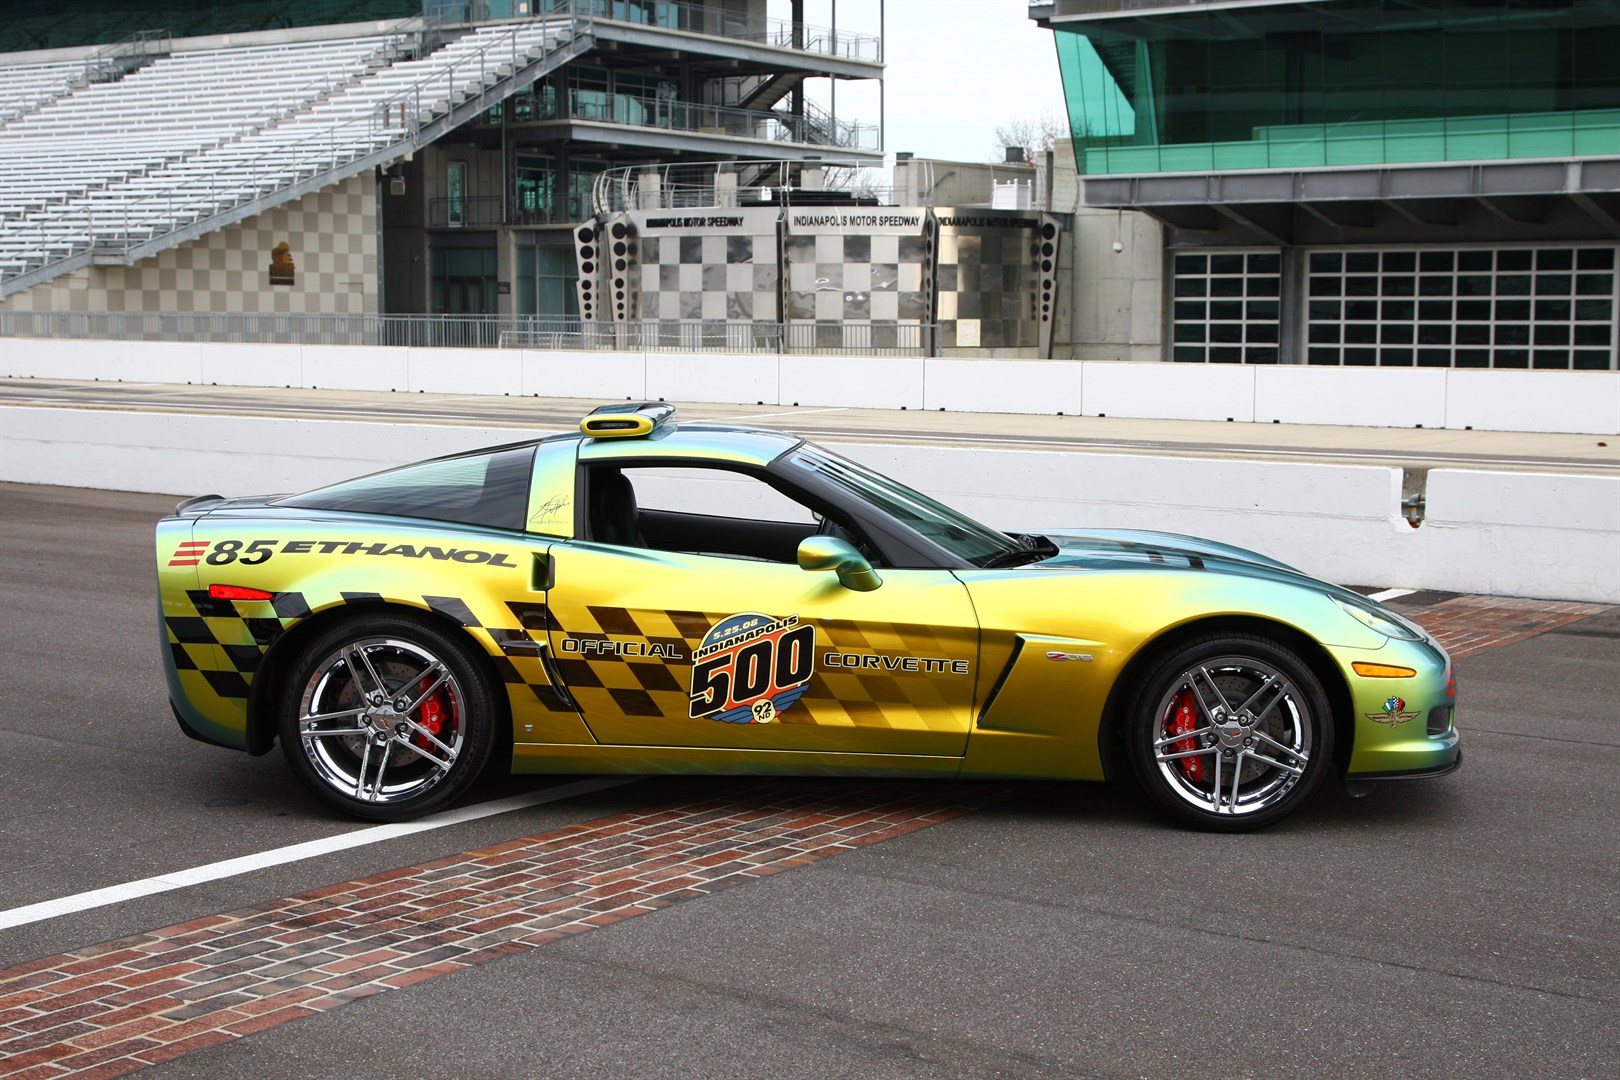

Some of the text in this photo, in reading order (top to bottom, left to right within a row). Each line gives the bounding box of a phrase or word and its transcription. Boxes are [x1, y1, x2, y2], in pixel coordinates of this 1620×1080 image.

[707, 216, 744, 227] SPEEDWAY
[793, 215, 920, 226] INDIANAPOLIS MOTOR SPEEDWAY
[280, 541, 517, 568] ETHANOL
[692, 614, 799, 660] INDIANAPOLIS
[713, 618, 759, 640] 5.25.08
[561, 637, 683, 660] OFFICIAL
[689, 624, 816, 719] 500
[824, 651, 970, 675] CORVETTE
[753, 701, 773, 717] 92
[758, 711, 771, 721] ND
